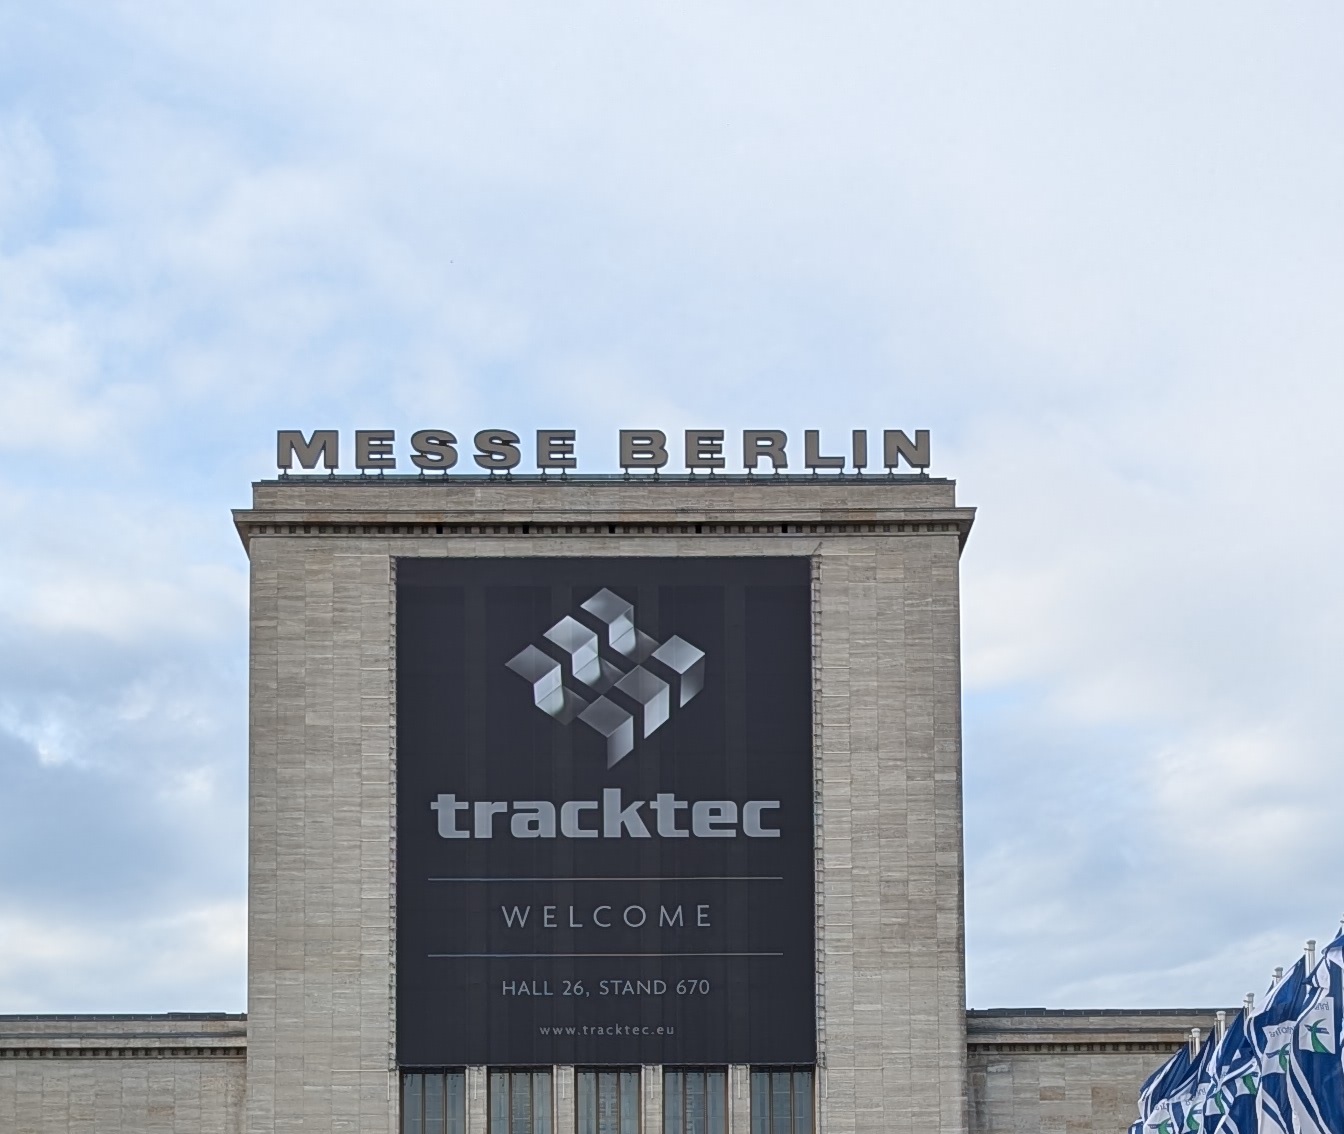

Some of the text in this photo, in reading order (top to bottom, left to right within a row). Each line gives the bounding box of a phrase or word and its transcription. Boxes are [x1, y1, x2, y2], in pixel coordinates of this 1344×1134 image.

[277, 429, 931, 470] MESSE BERLIN
[430, 788, 781, 839] tracktec
[501, 905, 712, 928] WELCOME
[501, 980, 711, 999] HALL 26, STAND 670
[539, 1024, 675, 1037] www.tracktec.eu
